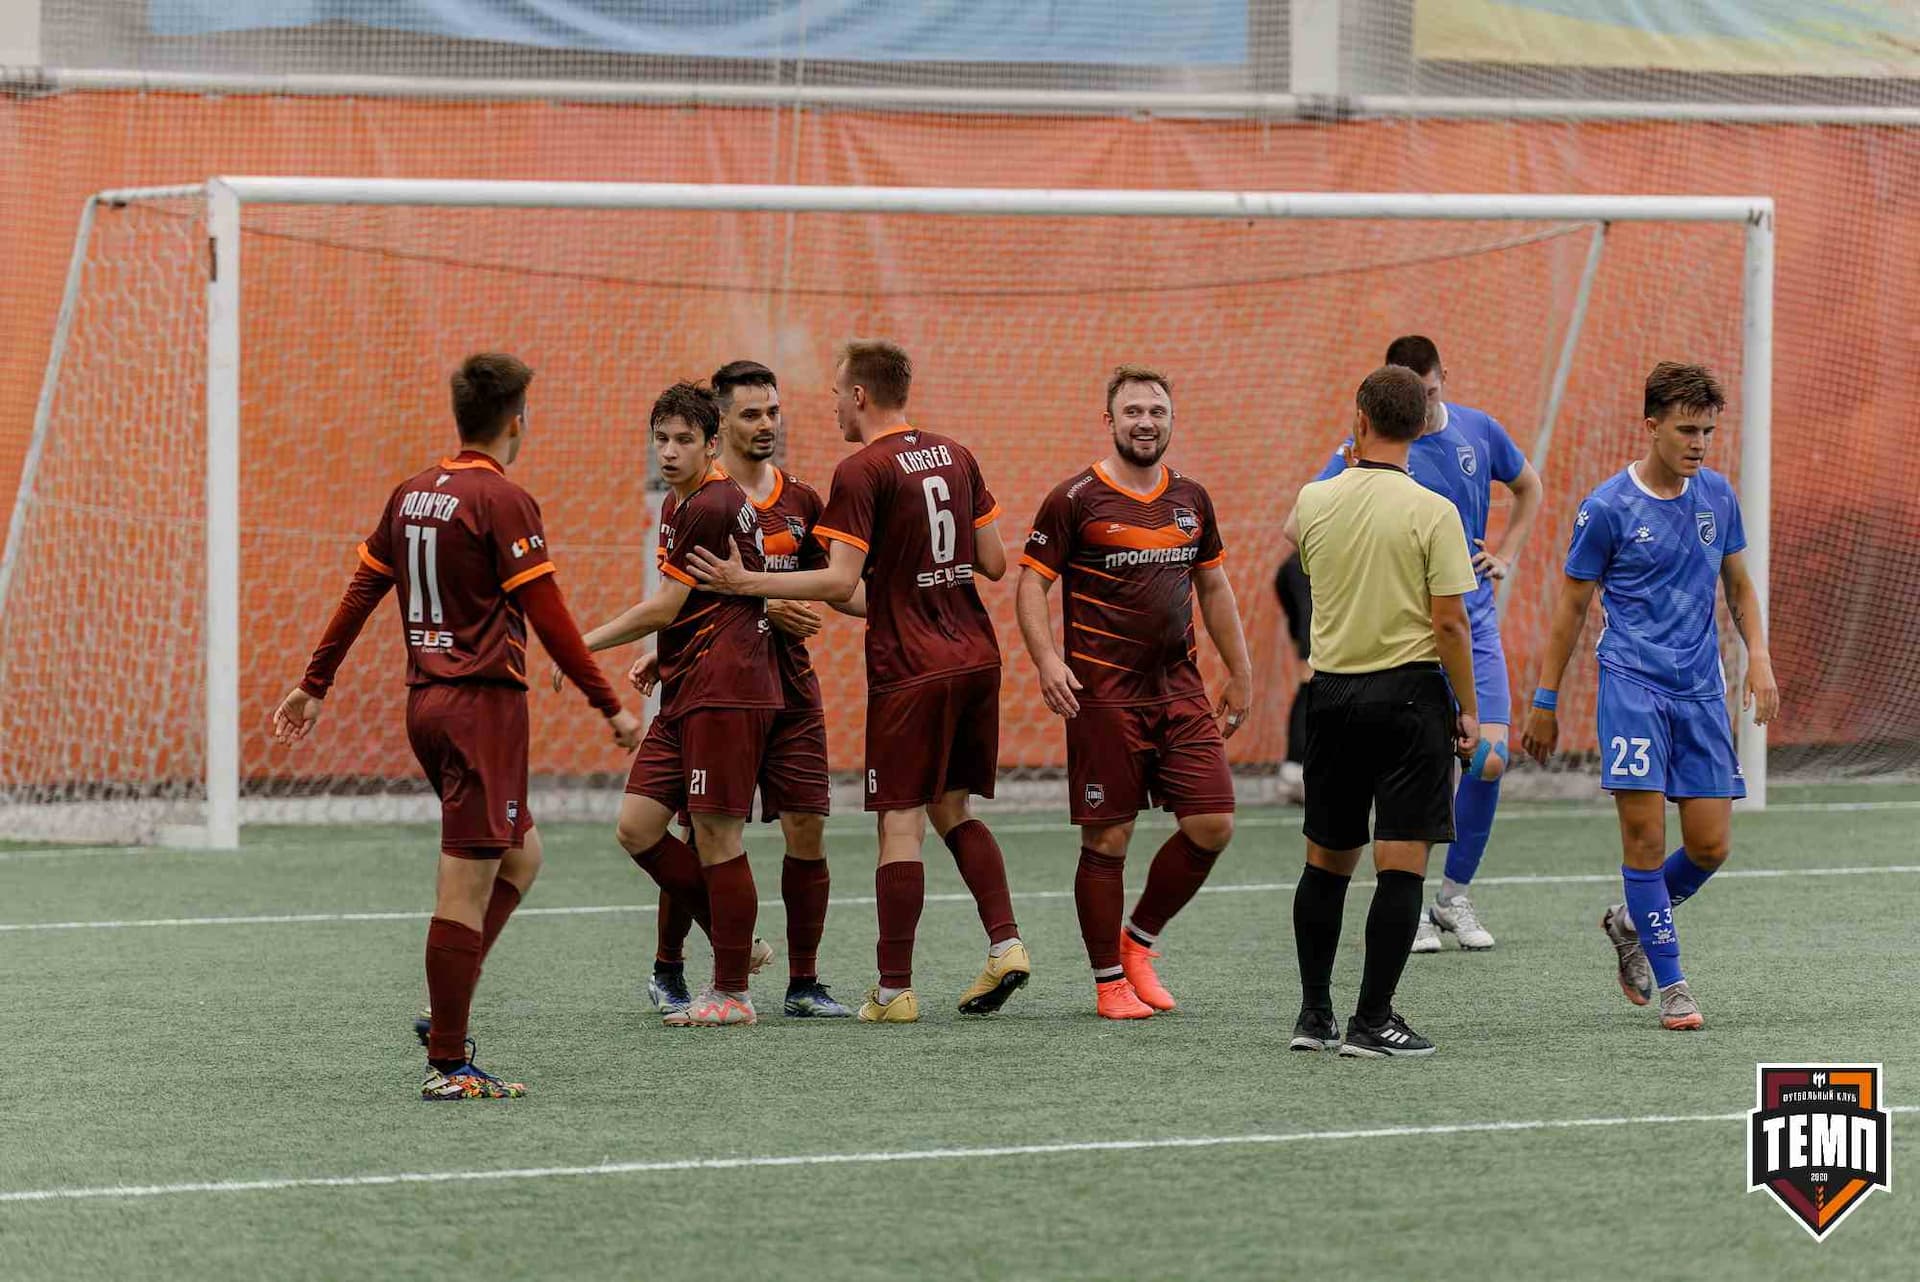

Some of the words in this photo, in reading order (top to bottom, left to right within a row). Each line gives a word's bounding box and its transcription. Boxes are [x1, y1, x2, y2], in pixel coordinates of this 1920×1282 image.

[896, 445, 952, 474] КНЯЗЕВ
[922, 475, 956, 564] 6
[405, 525, 443, 623] 11
[917, 564, 972, 587] SEUS
[1610, 736, 1650, 777] 23
[689, 769, 706, 794] 21
[868, 769, 878, 793] 6
[1648, 908, 1672, 927] 23
